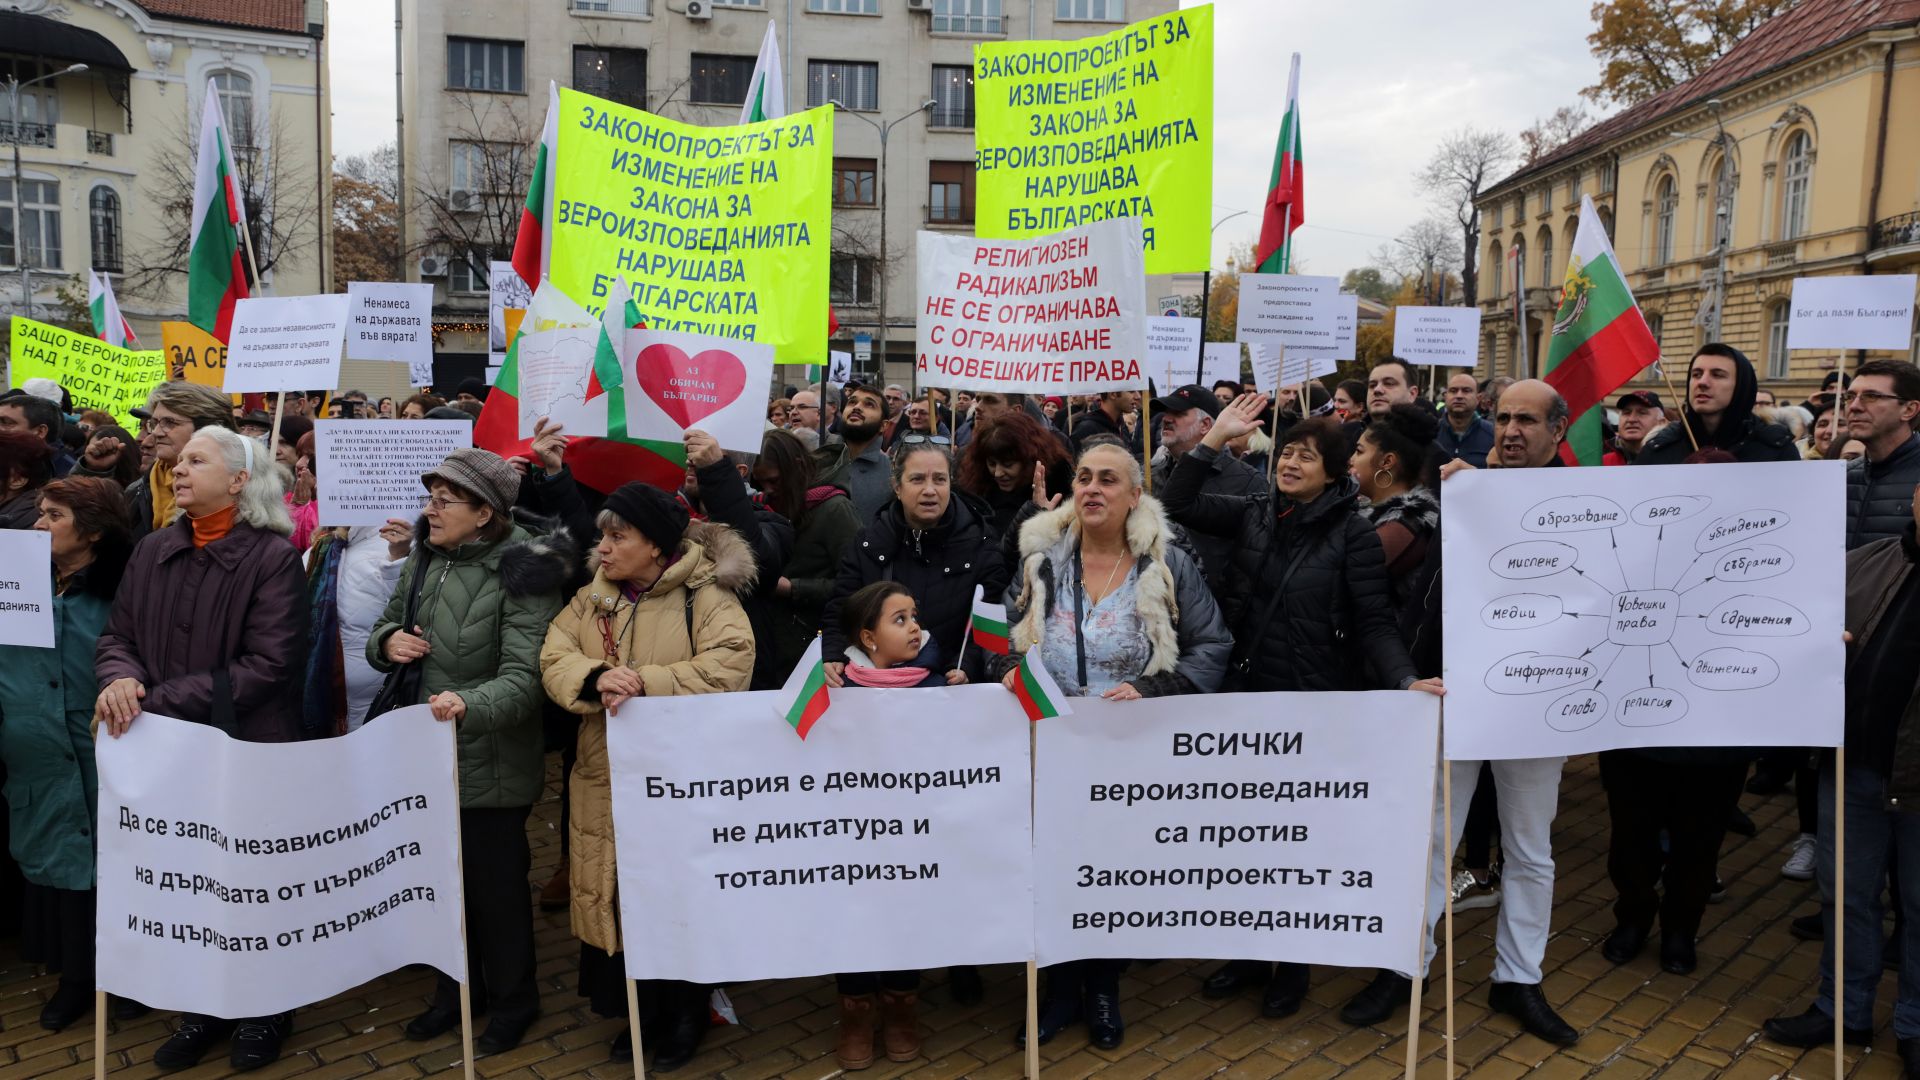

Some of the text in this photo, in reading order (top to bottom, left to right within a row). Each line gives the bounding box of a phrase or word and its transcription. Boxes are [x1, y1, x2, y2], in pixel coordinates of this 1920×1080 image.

[978, 16, 1190, 79] ЗАКОНОПРОЕКТЪТ ЗА
[1009, 60, 1159, 107] ИЗМЕНЕНИЕ НА
[1030, 98, 1137, 136] ЗАКОНА ЗА
[580, 106, 814, 159] ЗАКОНОПРОЕКТЪТ ЗА
[611, 149, 778, 189] ИЗМЕНЕНИЕ НА
[1025, 165, 1139, 198] НАРУШАВА
[630, 186, 752, 219] ЗАКОНА ЗА
[1008, 195, 1153, 230] БЪЛГАРСКАТА
[559, 200, 810, 255] ВЕРОИЗПОВЕДАНИЯТА
[974, 236, 1088, 267] РЕЛИГИОЗЕН
[617, 248, 745, 283] НАРУШАВА
[957, 266, 1097, 298] РАДИКАЛИЗЪМ
[1257, 284, 1313, 292] Законопроектът
[364, 297, 410, 309] Ненамеса
[592, 274, 758, 315] БЛГАРСКАТА
[1161, 299, 1179, 309] ЗОНА
[355, 314, 421, 326] на държавата
[926, 296, 1120, 324] НЕ СЕ ОГРАНИЧАВА
[1797, 307, 1907, 318] Бог да пази България!
[19, 323, 68, 347] ЗАЩО
[239, 325, 248, 334] Да
[259, 326, 282, 334] запази
[282, 323, 336, 332] независимостта
[360, 331, 418, 344] във вярата!
[931, 325, 1111, 352] С ОГРАНИЧАВАНЕ
[1156, 335, 1193, 343] държавата
[1242, 327, 1303, 336] междурелигиозна
[252, 343, 289, 352] държавата
[299, 340, 330, 350] църквата
[22, 344, 110, 378] НАД 1 % ОТ
[252, 360, 284, 369] църквата
[284, 359, 293, 367] от
[293, 357, 330, 367] държавата
[685, 367, 699, 375] АЗ
[935, 354, 1141, 382] ЧОВЕШКИТЕ ПРАВА
[60, 373, 129, 402] МОГАТ ДА
[669, 378, 715, 389] ОБИЧАМ
[663, 390, 718, 403] БЪЛГАРИЯ
[1538, 509, 1618, 528] образование
[1709, 517, 1776, 541] убеждения
[1723, 556, 1781, 575] събрания
[1492, 605, 1537, 620] медии
[1618, 595, 1666, 613] Човешки
[1616, 616, 1657, 632] права
[1504, 664, 1589, 683] информация
[1695, 660, 1758, 675] движения
[1561, 698, 1597, 717] слово
[1623, 695, 1673, 716] религия
[1172, 731, 1303, 757] ВСИЧКИ
[645, 766, 1001, 800] България е демокрация
[1090, 781, 1369, 806] вероизповедания
[119, 794, 428, 855] Да се запази независимостта
[712, 817, 930, 844] не диктатура и
[1155, 824, 1309, 848] са против
[135, 841, 422, 904] на държавата от църквата
[714, 860, 940, 890] тоталитаризъм
[1076, 864, 1374, 890] Законопроектът за
[128, 884, 435, 952] и на църквата от държавата
[1072, 910, 1384, 934] вероизповеданията
